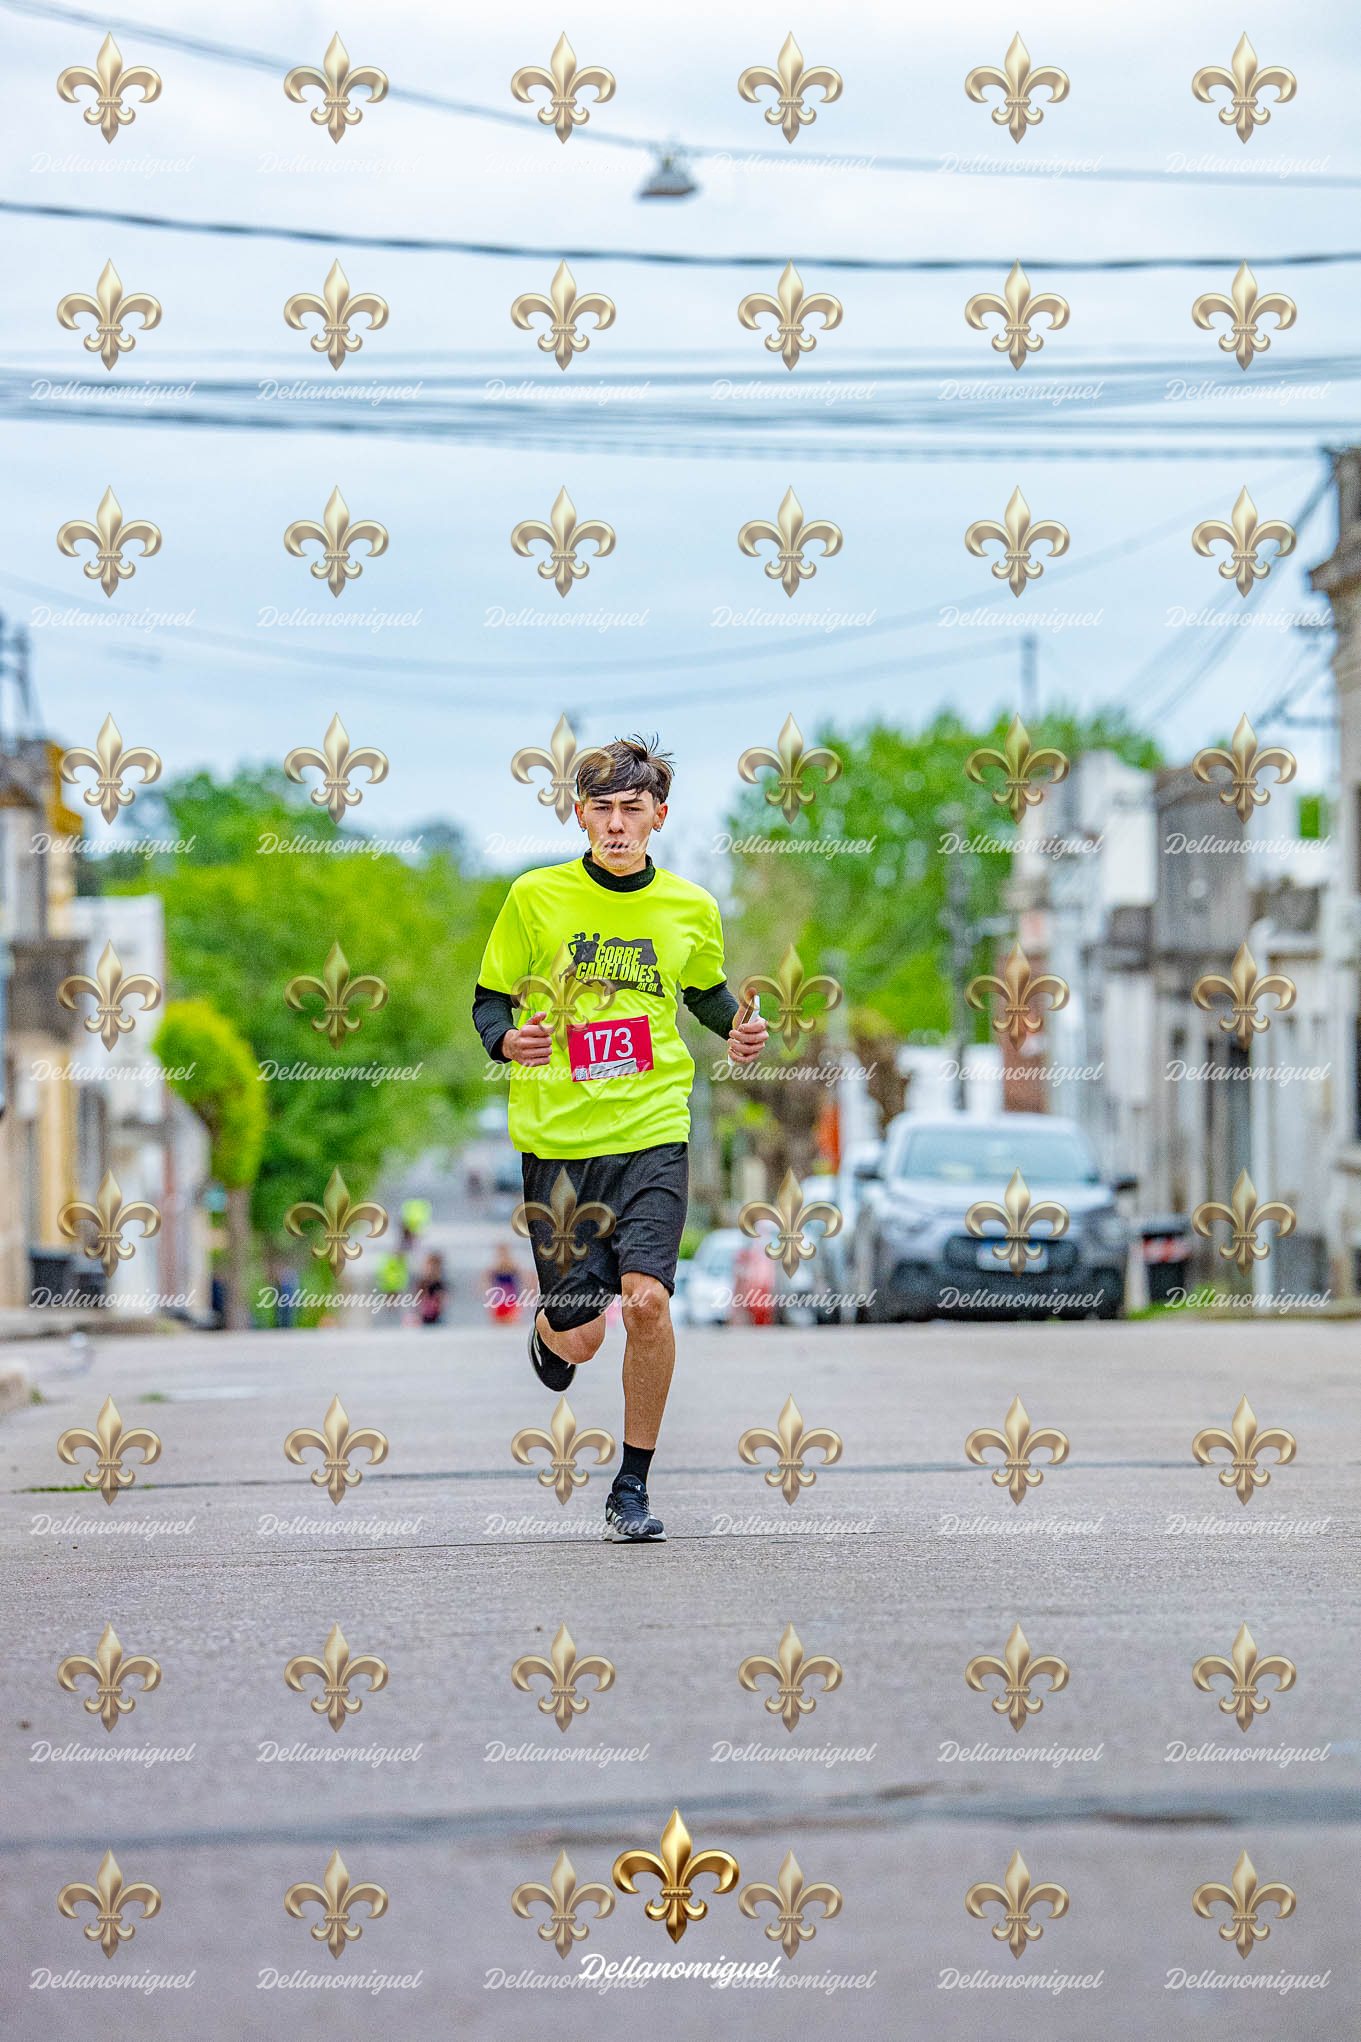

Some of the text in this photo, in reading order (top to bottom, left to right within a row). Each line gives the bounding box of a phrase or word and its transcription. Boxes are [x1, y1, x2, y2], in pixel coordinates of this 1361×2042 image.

[595, 946, 642, 966] CORRE
[576, 962, 657, 983] CANELONES
[583, 1027, 634, 1062] 173
